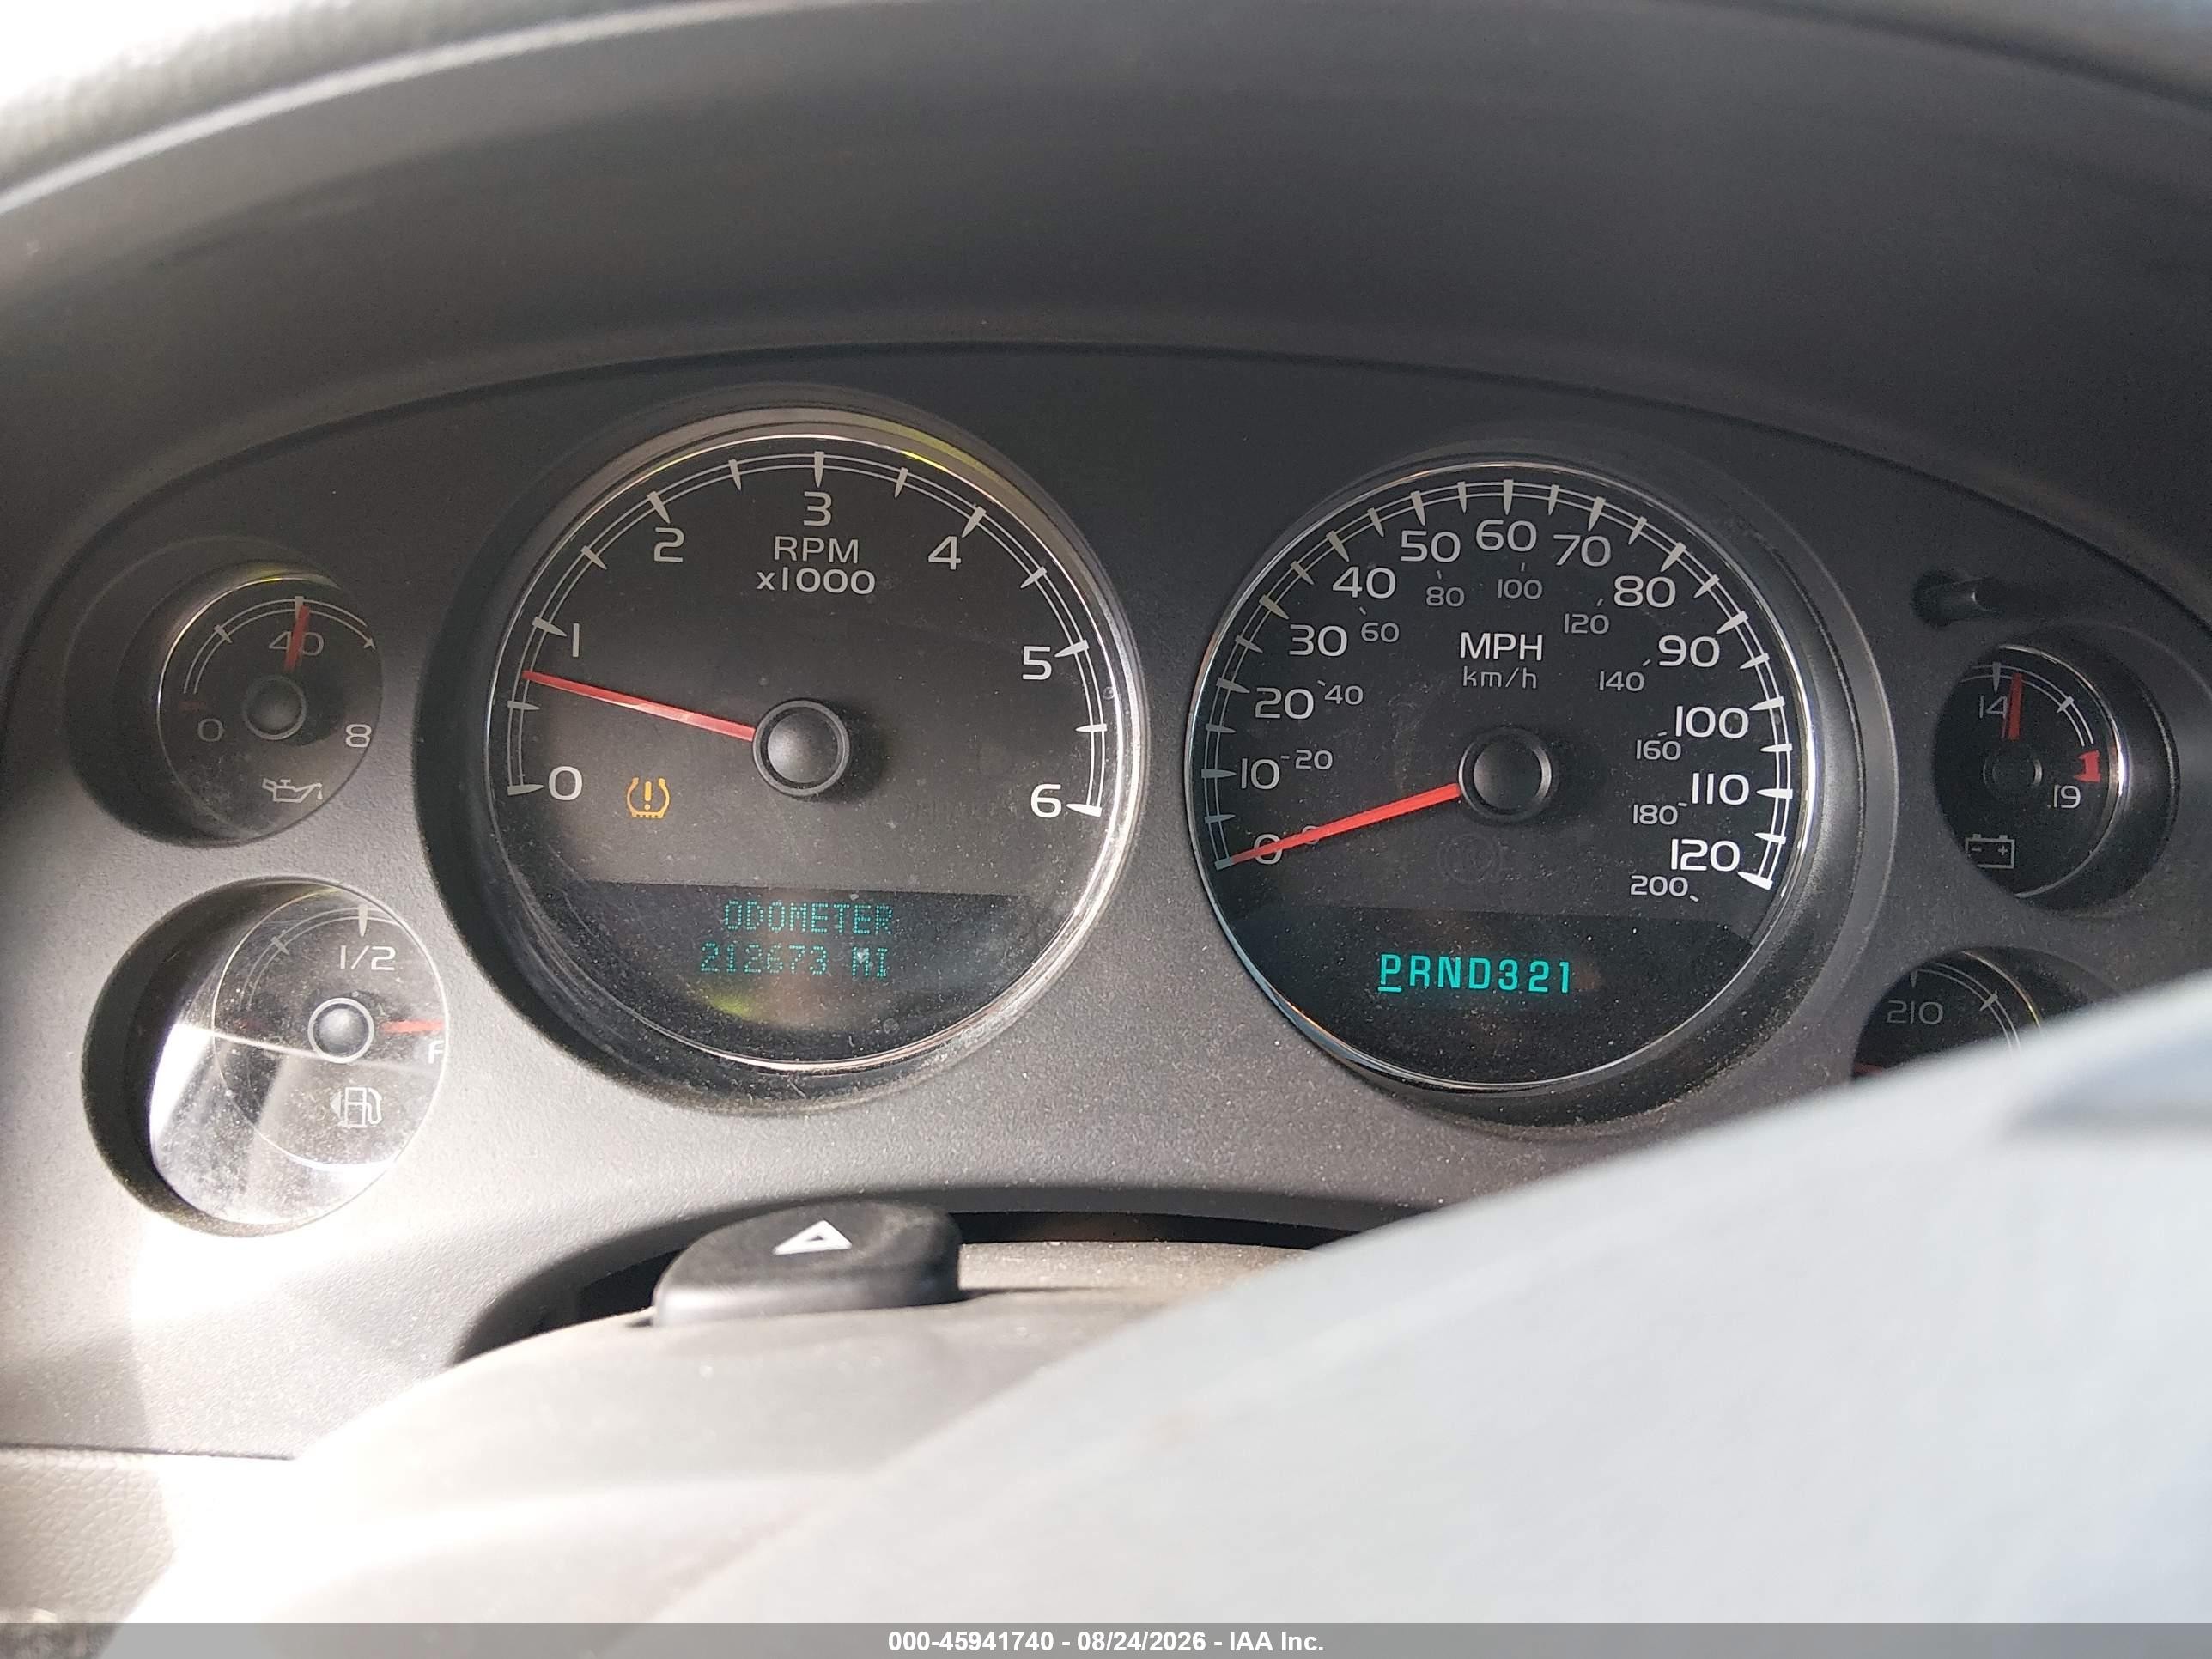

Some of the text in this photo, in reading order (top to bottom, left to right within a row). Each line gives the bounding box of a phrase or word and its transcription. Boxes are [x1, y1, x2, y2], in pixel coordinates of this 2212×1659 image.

[803, 491, 832, 526] 3
[653, 528, 684, 562] 2
[774, 537, 859, 563] RPM
[1400, 530, 1461, 563] 50
[1475, 520, 1537, 553] 60
[1552, 533, 1612, 568] 70
[927, 537, 961, 569] 4
[756, 568, 876, 595] x1000
[1332, 567, 1397, 599] 40
[1425, 586, 1466, 608] 80
[1496, 578, 1543, 599] 100
[1613, 575, 1677, 609] 80
[1360, 622, 1401, 643] 60
[1563, 612, 1611, 635] 120
[571, 623, 580, 658] 1
[1288, 624, 1348, 658] 30
[1459, 632, 1544, 661] MPH
[1656, 635, 1721, 668] 90
[1022, 646, 1053, 681] 5
[1462, 665, 1538, 690] km/h
[1324, 684, 1364, 706] 40
[1599, 671, 1645, 693] 140
[1255, 687, 1315, 720] 20
[1978, 694, 2009, 718] 14
[198, 718, 224, 743] 0
[1674, 706, 1749, 738] 100
[1294, 748, 1334, 770] 20
[1636, 739, 1681, 762] 160
[548, 766, 583, 800] 0
[1239, 758, 1280, 789] 10
[1691, 773, 1749, 805] 110
[1030, 783, 1062, 818] 6
[2052, 785, 2081, 809] 19
[1632, 804, 1678, 825] 180
[1253, 833, 1283, 865] 0
[1670, 838, 1741, 871] 120
[1630, 874, 1688, 896] 200
[724, 900, 893, 935] ODOMETER
[340, 945, 396, 970] 1/2
[701, 942, 888, 977] 212673 MI
[1378, 953, 1571, 994] PRND321
[1887, 1000, 1943, 1024] 210
